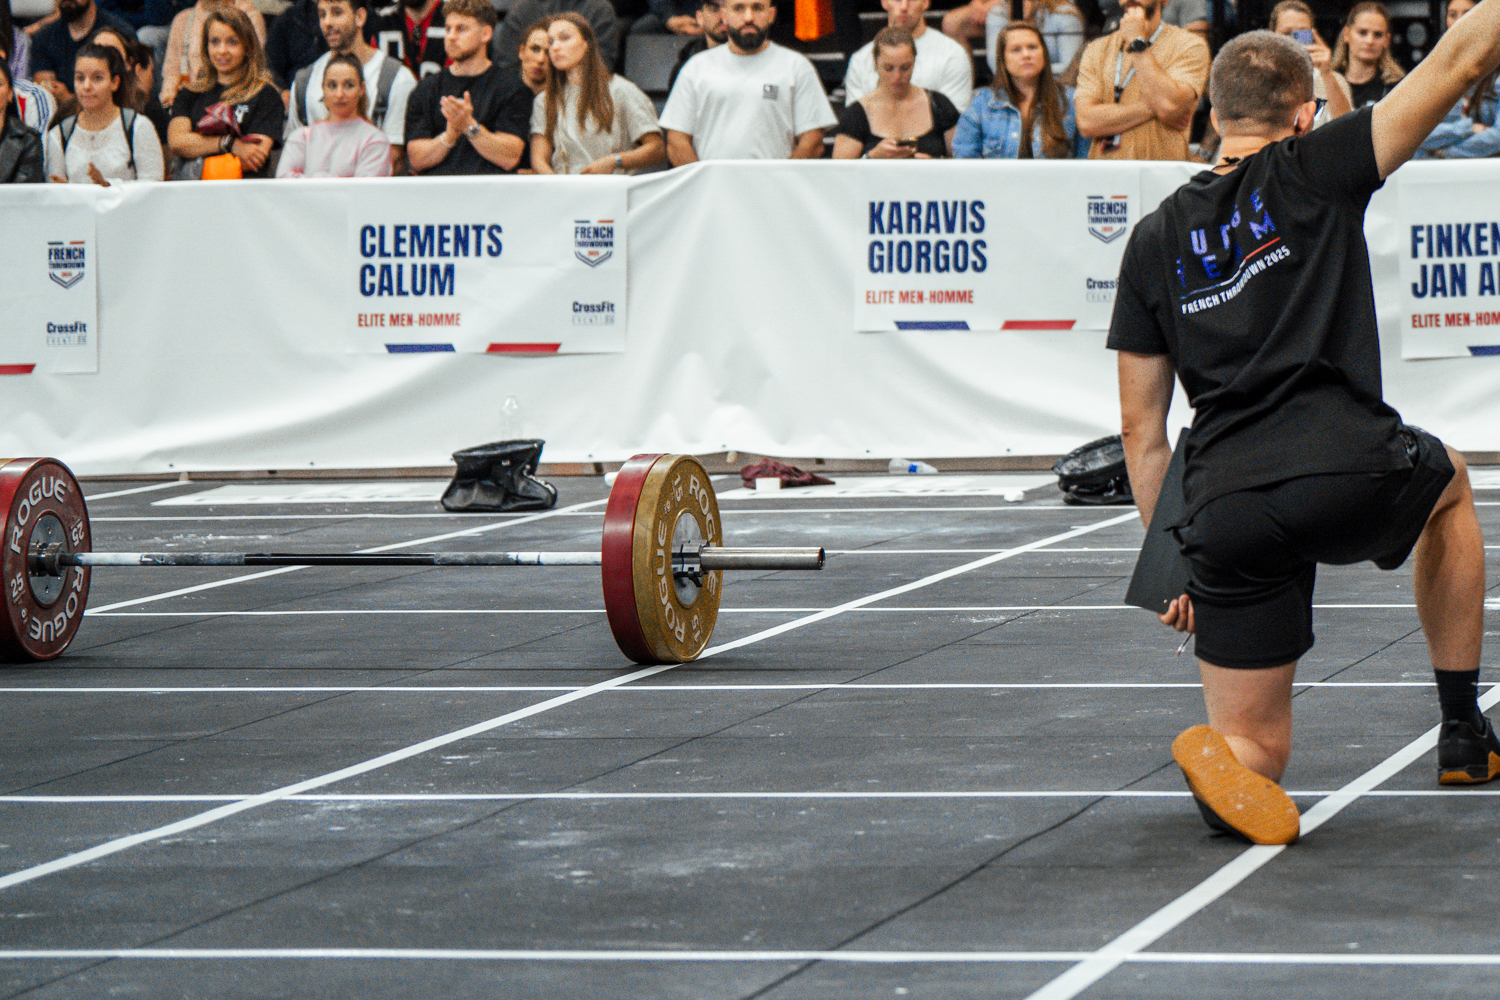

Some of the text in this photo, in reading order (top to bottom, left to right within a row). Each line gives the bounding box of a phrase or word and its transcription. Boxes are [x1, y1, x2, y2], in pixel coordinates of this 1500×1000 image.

[868, 200, 985, 235] KARAVIS
[1087, 202, 1128, 216] FRENCH
[359, 223, 503, 258] CLEMENTS
[574, 226, 614, 239] FRENCH
[48, 247, 85, 260] FRENCH
[867, 239, 987, 274] GIORGOS
[358, 263, 455, 297] CALUM
[1181, 293, 1221, 315] FRENCH
[1263, 243, 1292, 268] 2025
[1411, 263, 1468, 299] JAN
[572, 301, 615, 313] CrossFit
[865, 289, 974, 305] ELITE MEN-HOMME
[46, 321, 87, 333] CrossFit
[357, 312, 462, 328] ELITE MEN-HOMME
[1411, 313, 1441, 329] ELITE
[10, 476, 67, 554] ROGUE
[656, 519, 686, 644] ROGUE
[29, 565, 85, 643] ROGUE
